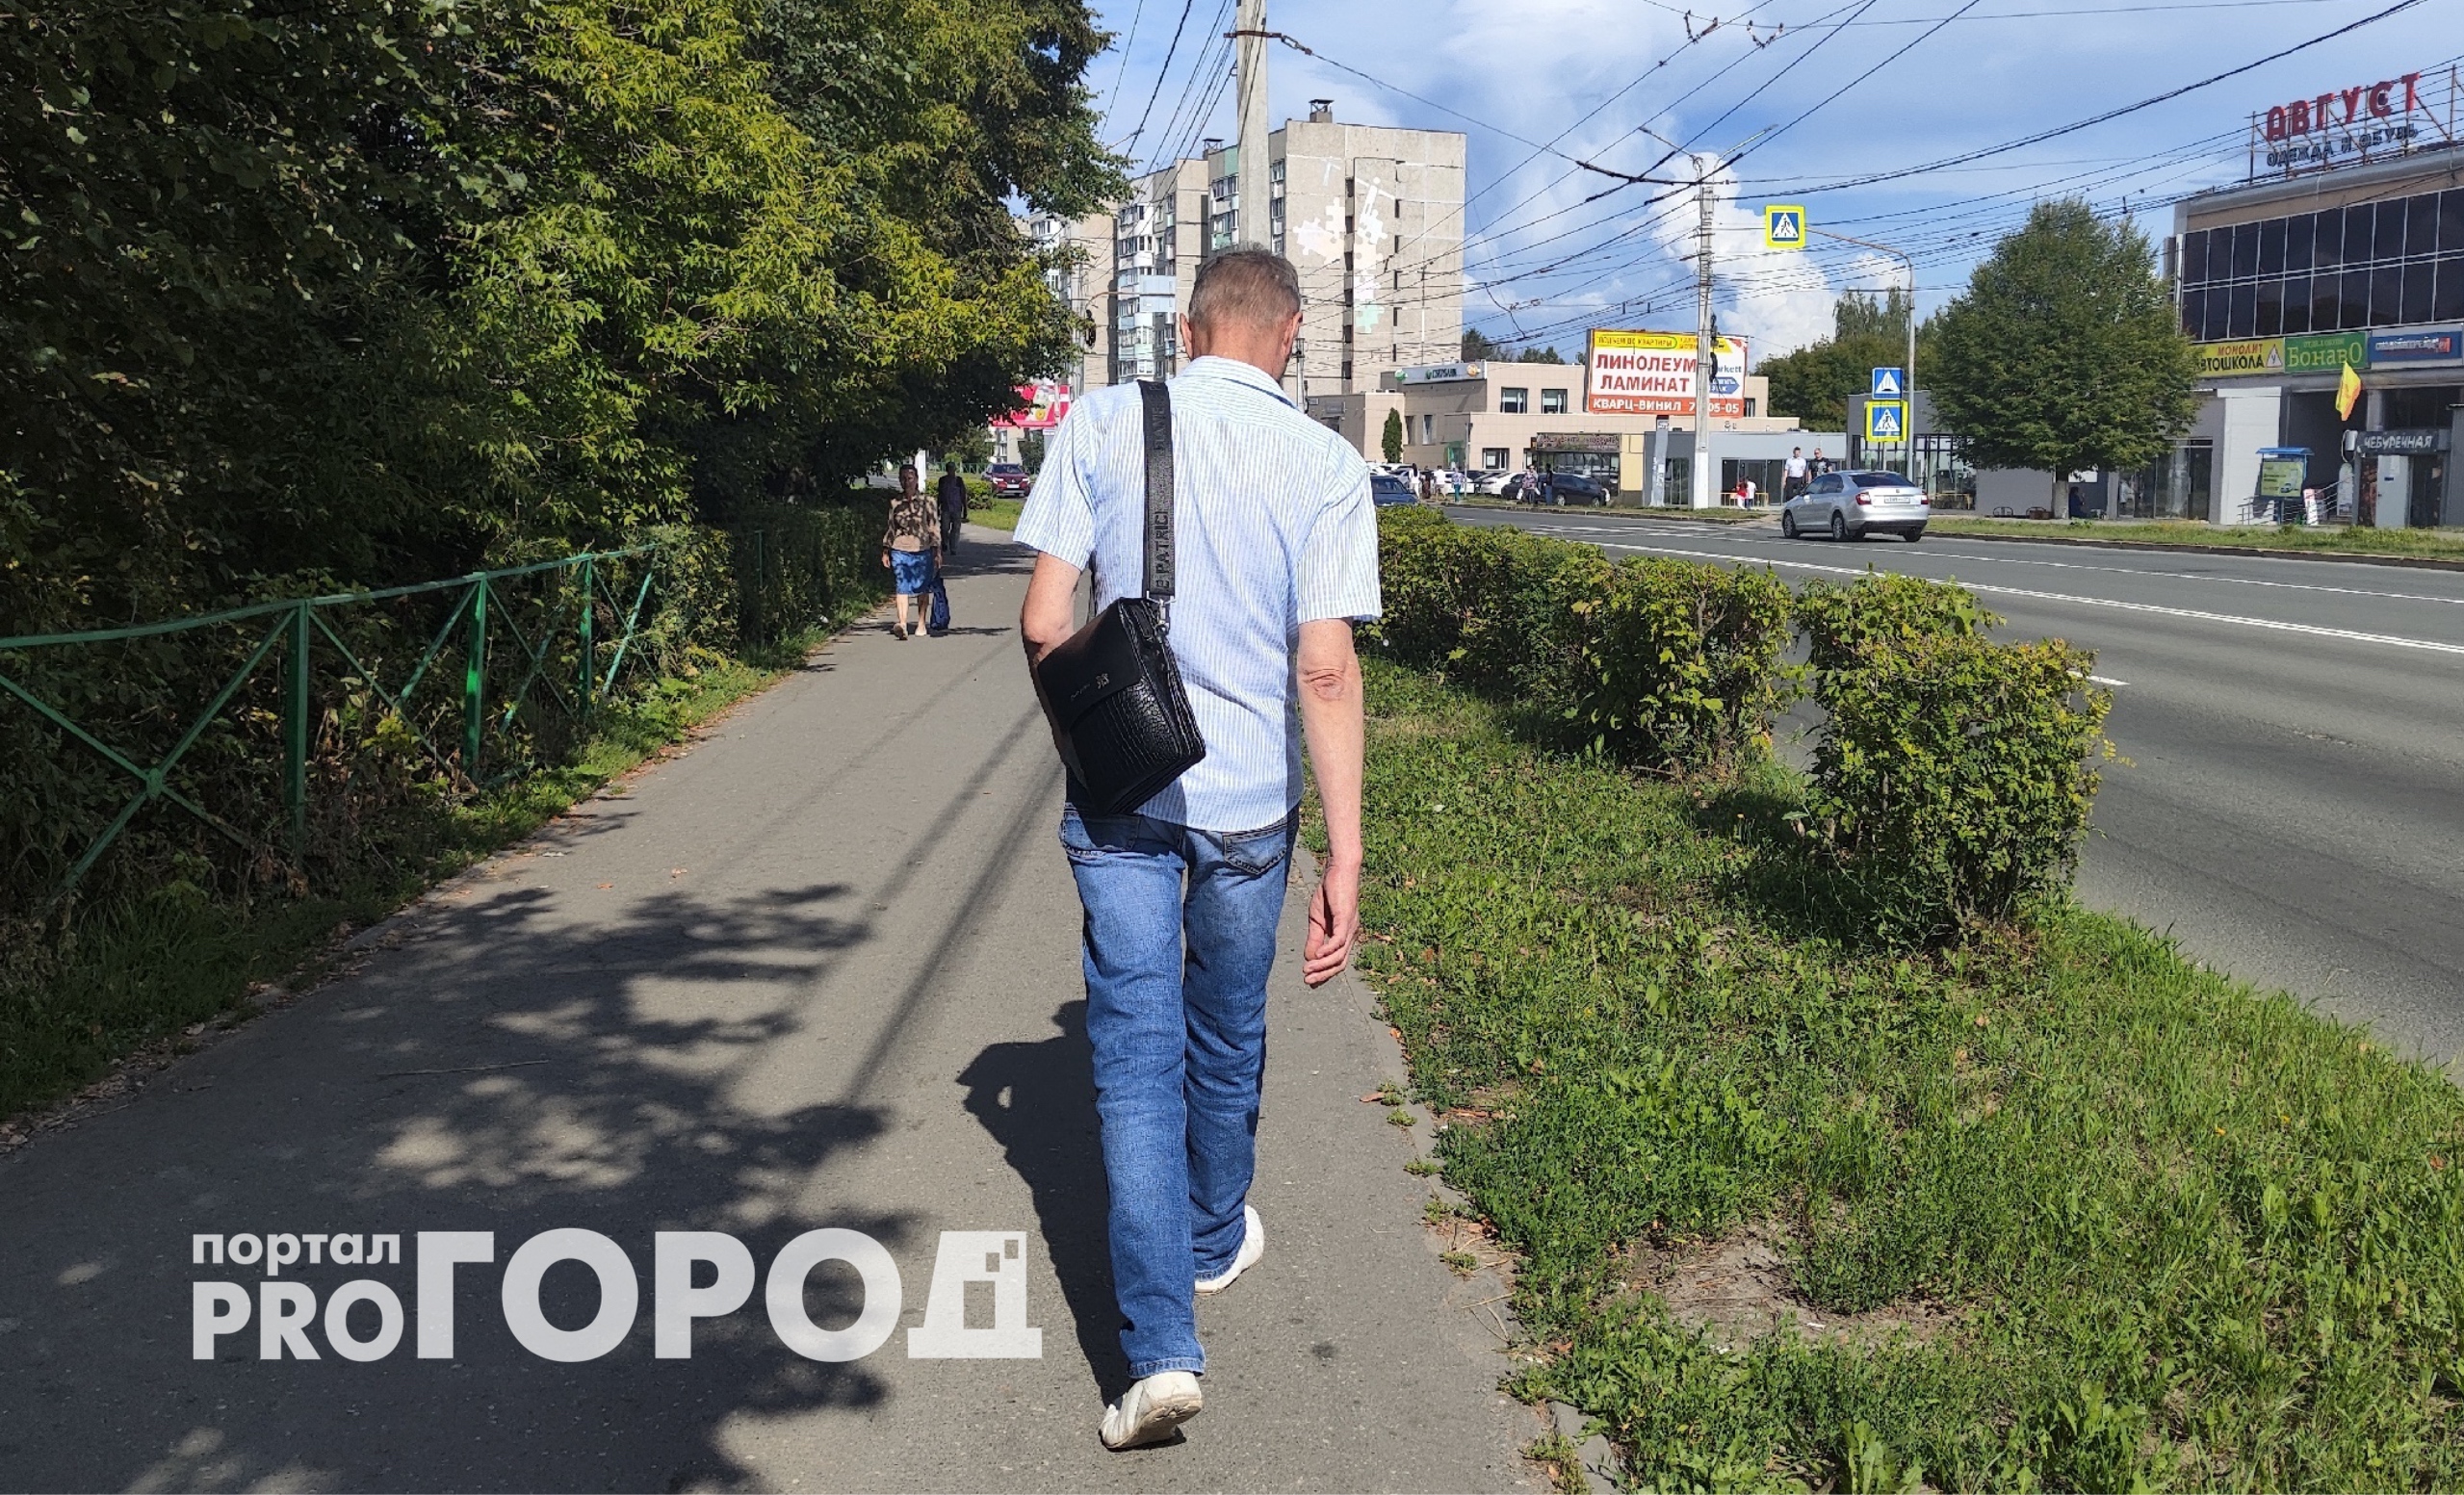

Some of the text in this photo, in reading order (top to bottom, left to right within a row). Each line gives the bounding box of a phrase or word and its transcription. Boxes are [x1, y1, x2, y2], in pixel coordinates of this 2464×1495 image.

[2267, 72, 2421, 142] АВГУСТ
[2267, 123, 2419, 167] ОДЕЖДА И ОБУВЬ
[2217, 343, 2263, 356] МОНОЛИТ
[1595, 353, 1697, 373] ЛИНОЛЕУМ
[1600, 374, 1690, 392] ЛАМИНАТ
[1593, 399, 1681, 412] КВАРЦ-ВИНИЛ
[2364, 435, 2433, 449] ЧЕБУРЕЧНАЯ
